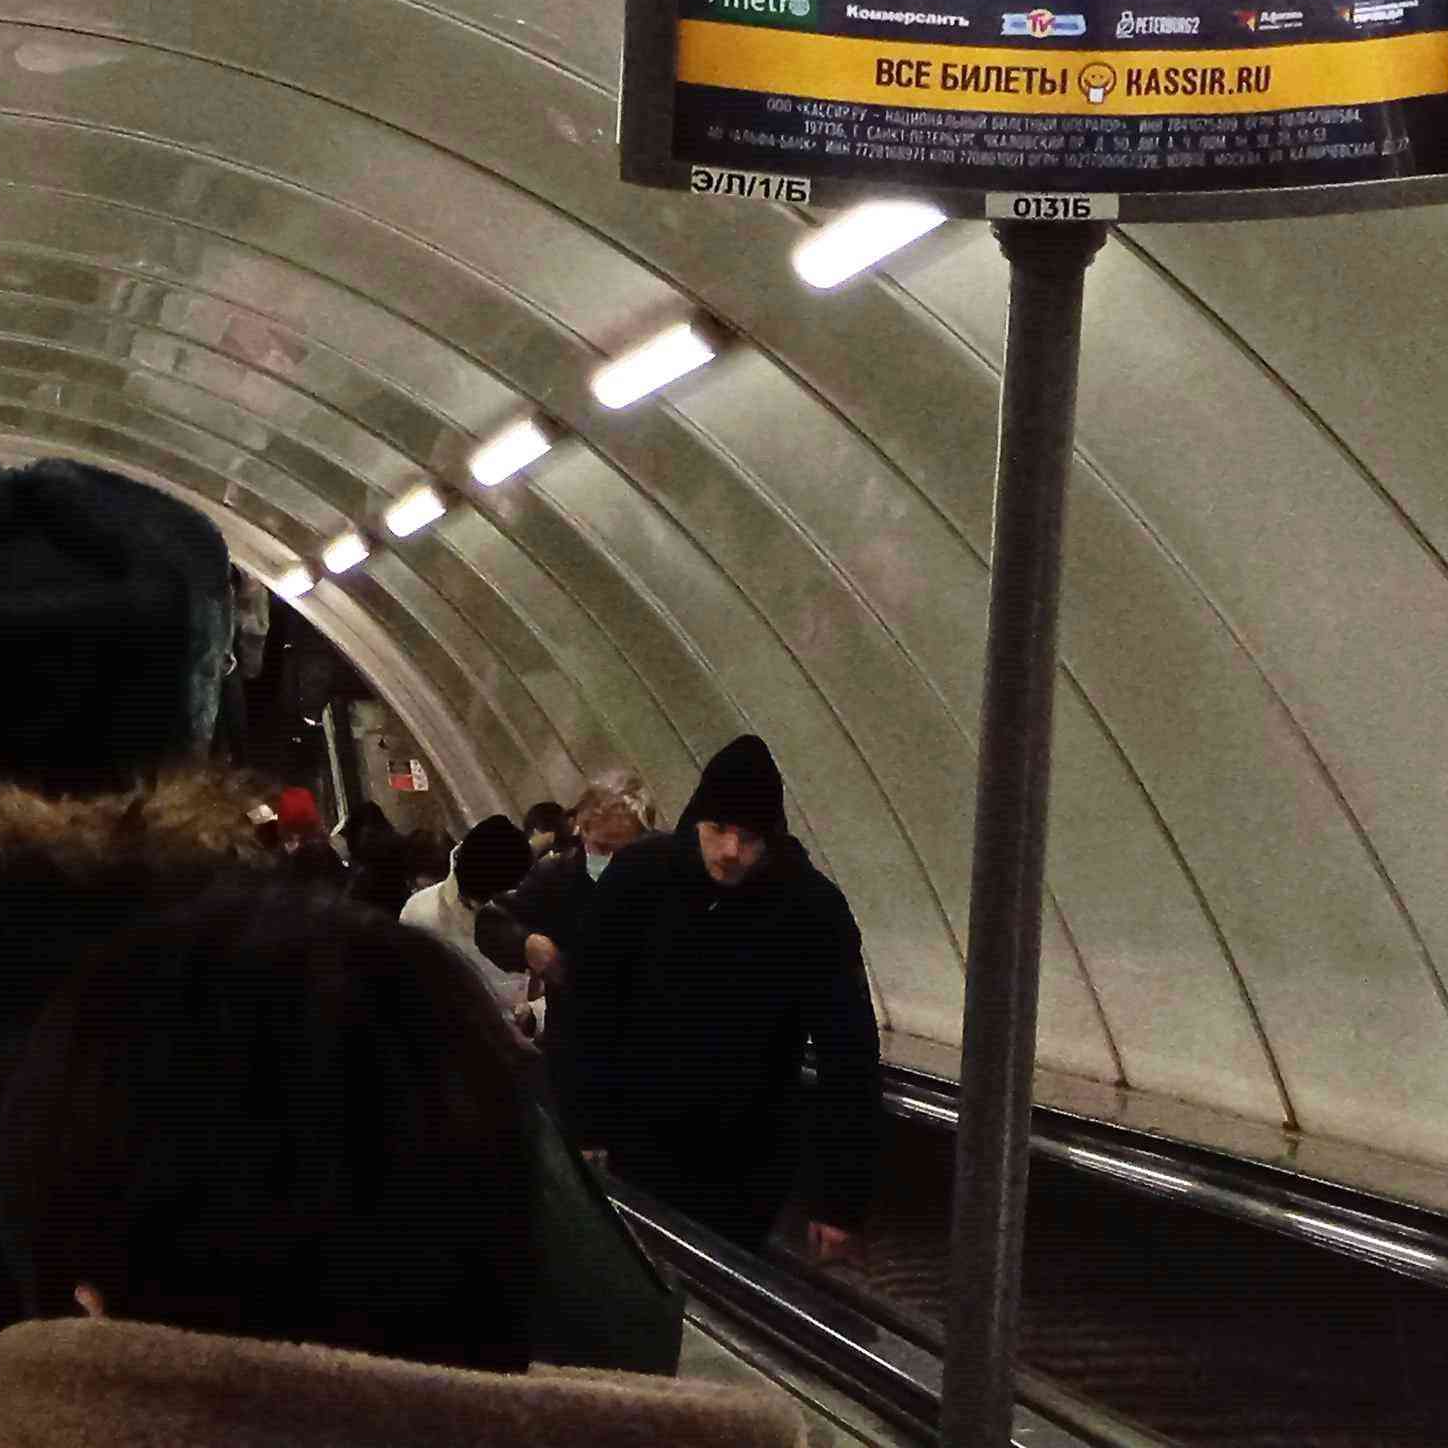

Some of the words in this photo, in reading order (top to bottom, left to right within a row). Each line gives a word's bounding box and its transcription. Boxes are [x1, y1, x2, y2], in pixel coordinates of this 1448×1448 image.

[875, 57, 933, 90] ВСЕ
[940, 62, 1069, 96] БИЛЕТЫ
[1124, 64, 1273, 97] KASSIR.RU
